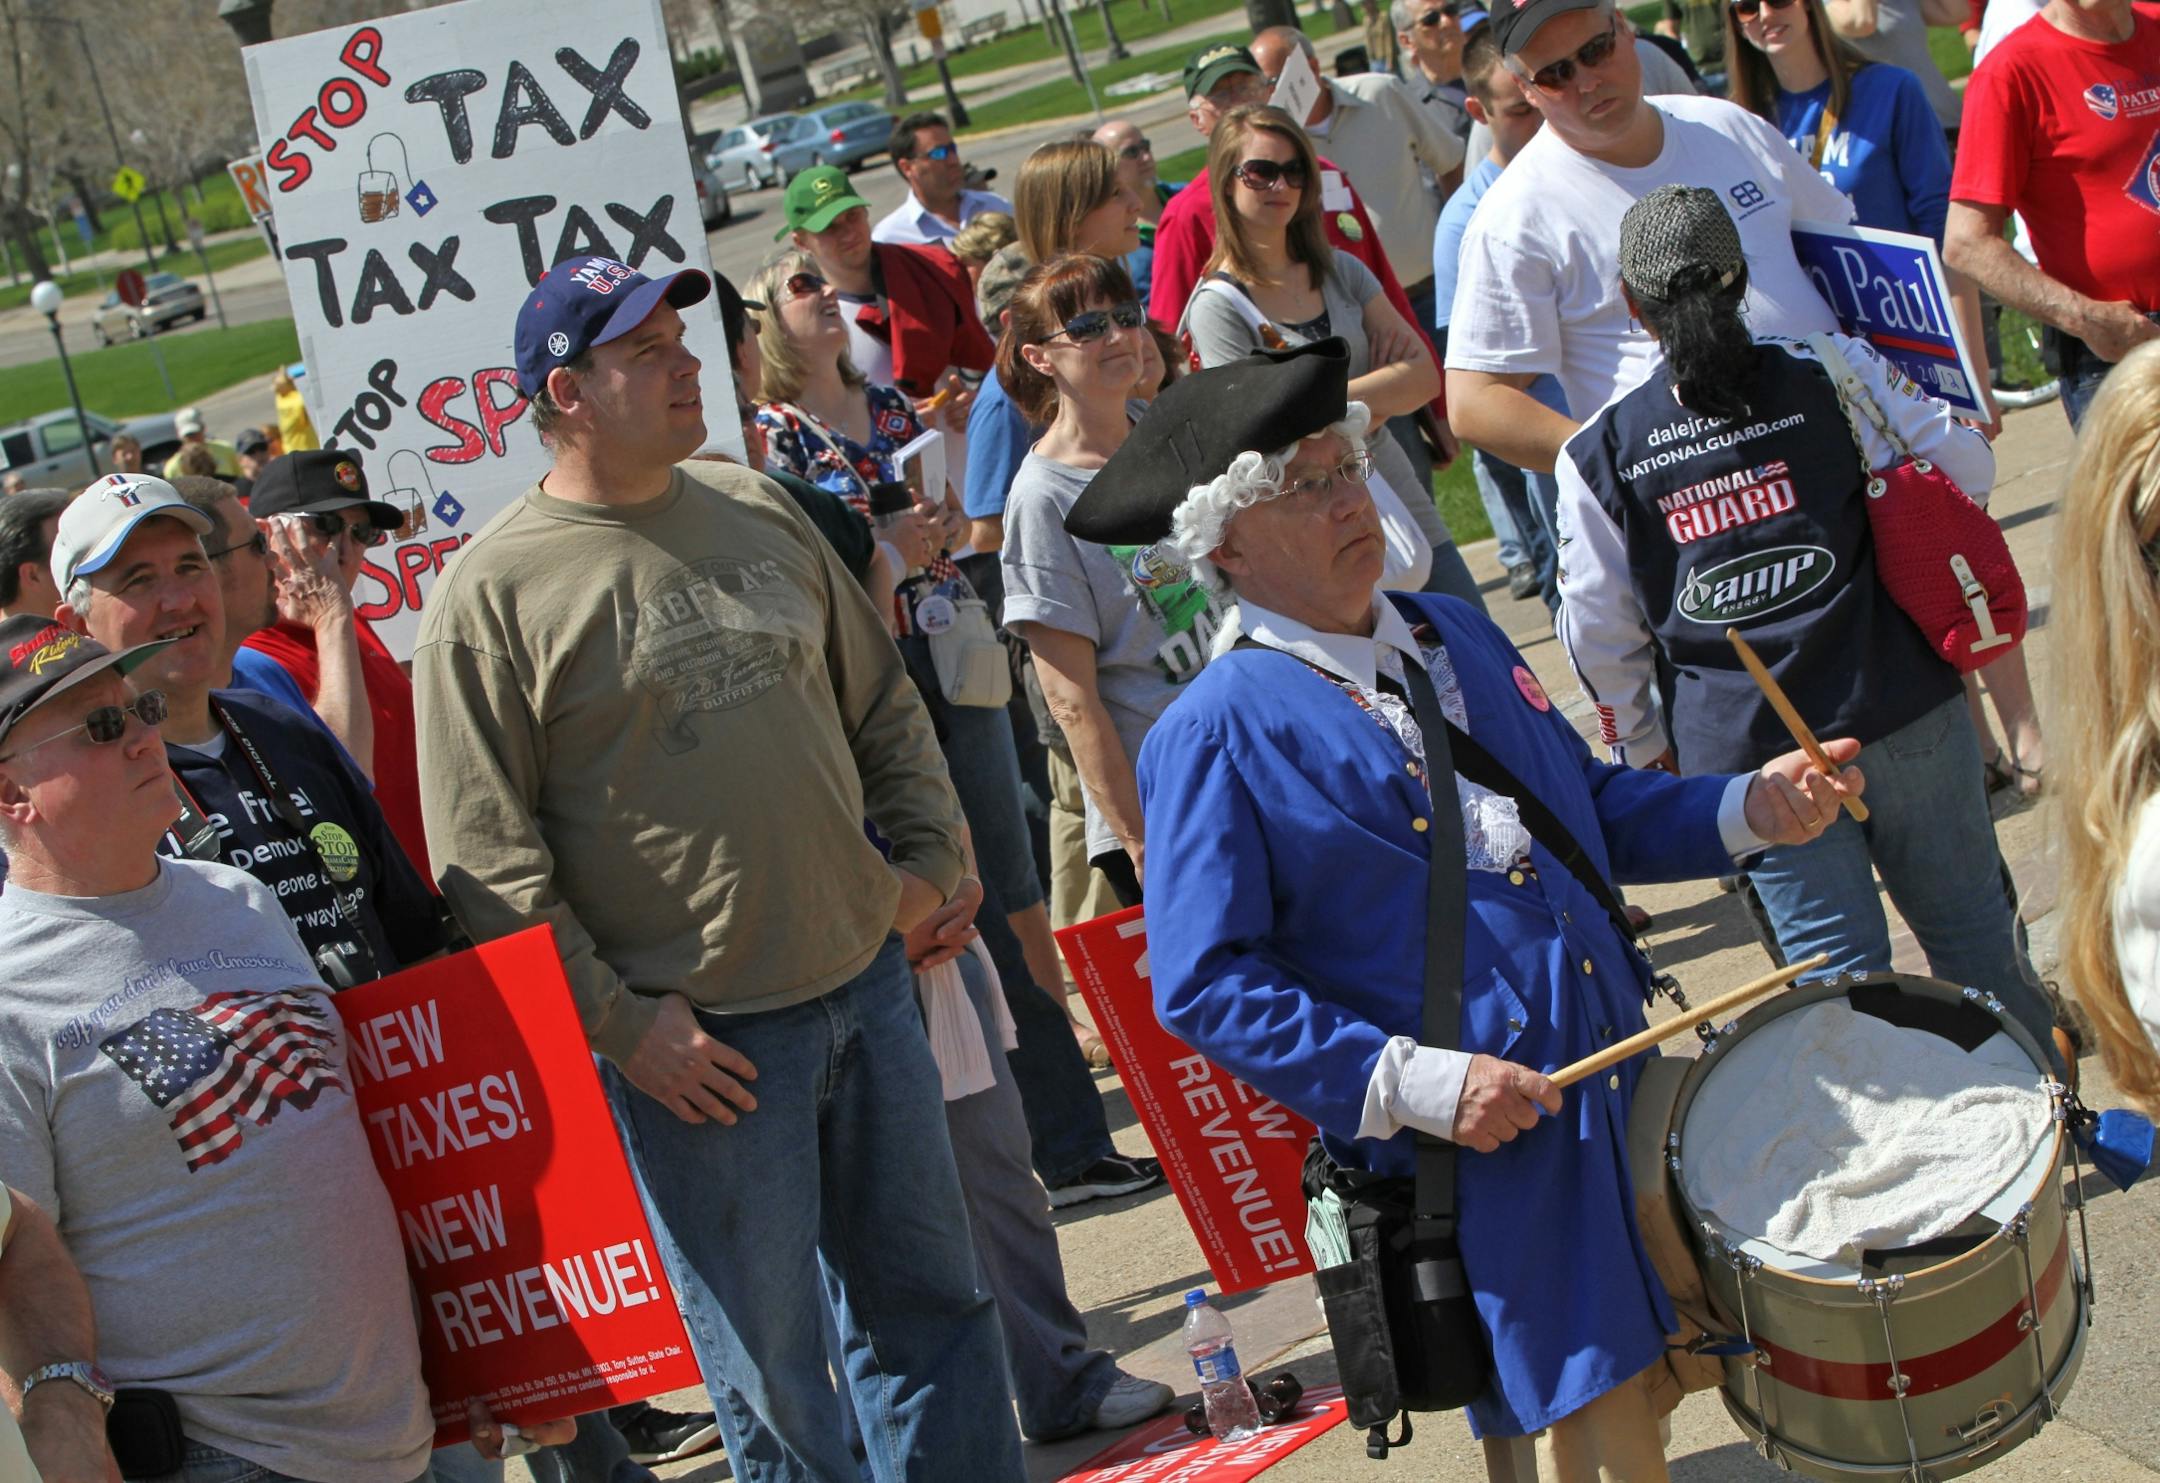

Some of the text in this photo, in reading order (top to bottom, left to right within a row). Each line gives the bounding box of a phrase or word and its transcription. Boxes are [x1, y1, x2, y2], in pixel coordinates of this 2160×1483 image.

[267, 26, 391, 193] STOP
[404, 37, 652, 165] TAX
[2121, 86, 2160, 109] PATR
[285, 195, 686, 328] TAX TAX
[587, 264, 640, 295] U.S.
[1832, 246, 1950, 338] Paul
[1618, 411, 1805, 484] NATIONALGUARD.com
[1656, 469, 1757, 514] NATIONAL
[1666, 477, 1797, 545] GUARD
[703, 673, 783, 710] OUTFITTER
[242, 736, 278, 790] DIGITAL
[354, 1000, 445, 1088] NEW
[368, 1070, 533, 1170] TAXES!
[1228, 1070, 1298, 1140] EW
[1168, 1053, 1300, 1273] REVENUE!
[401, 1184, 507, 1269] NEW
[431, 1238, 660, 1352] REVENUE!
[605, 1367, 638, 1385] responsible
[611, 1357, 627, 1371] Tony
[647, 1348, 664, 1361] State
